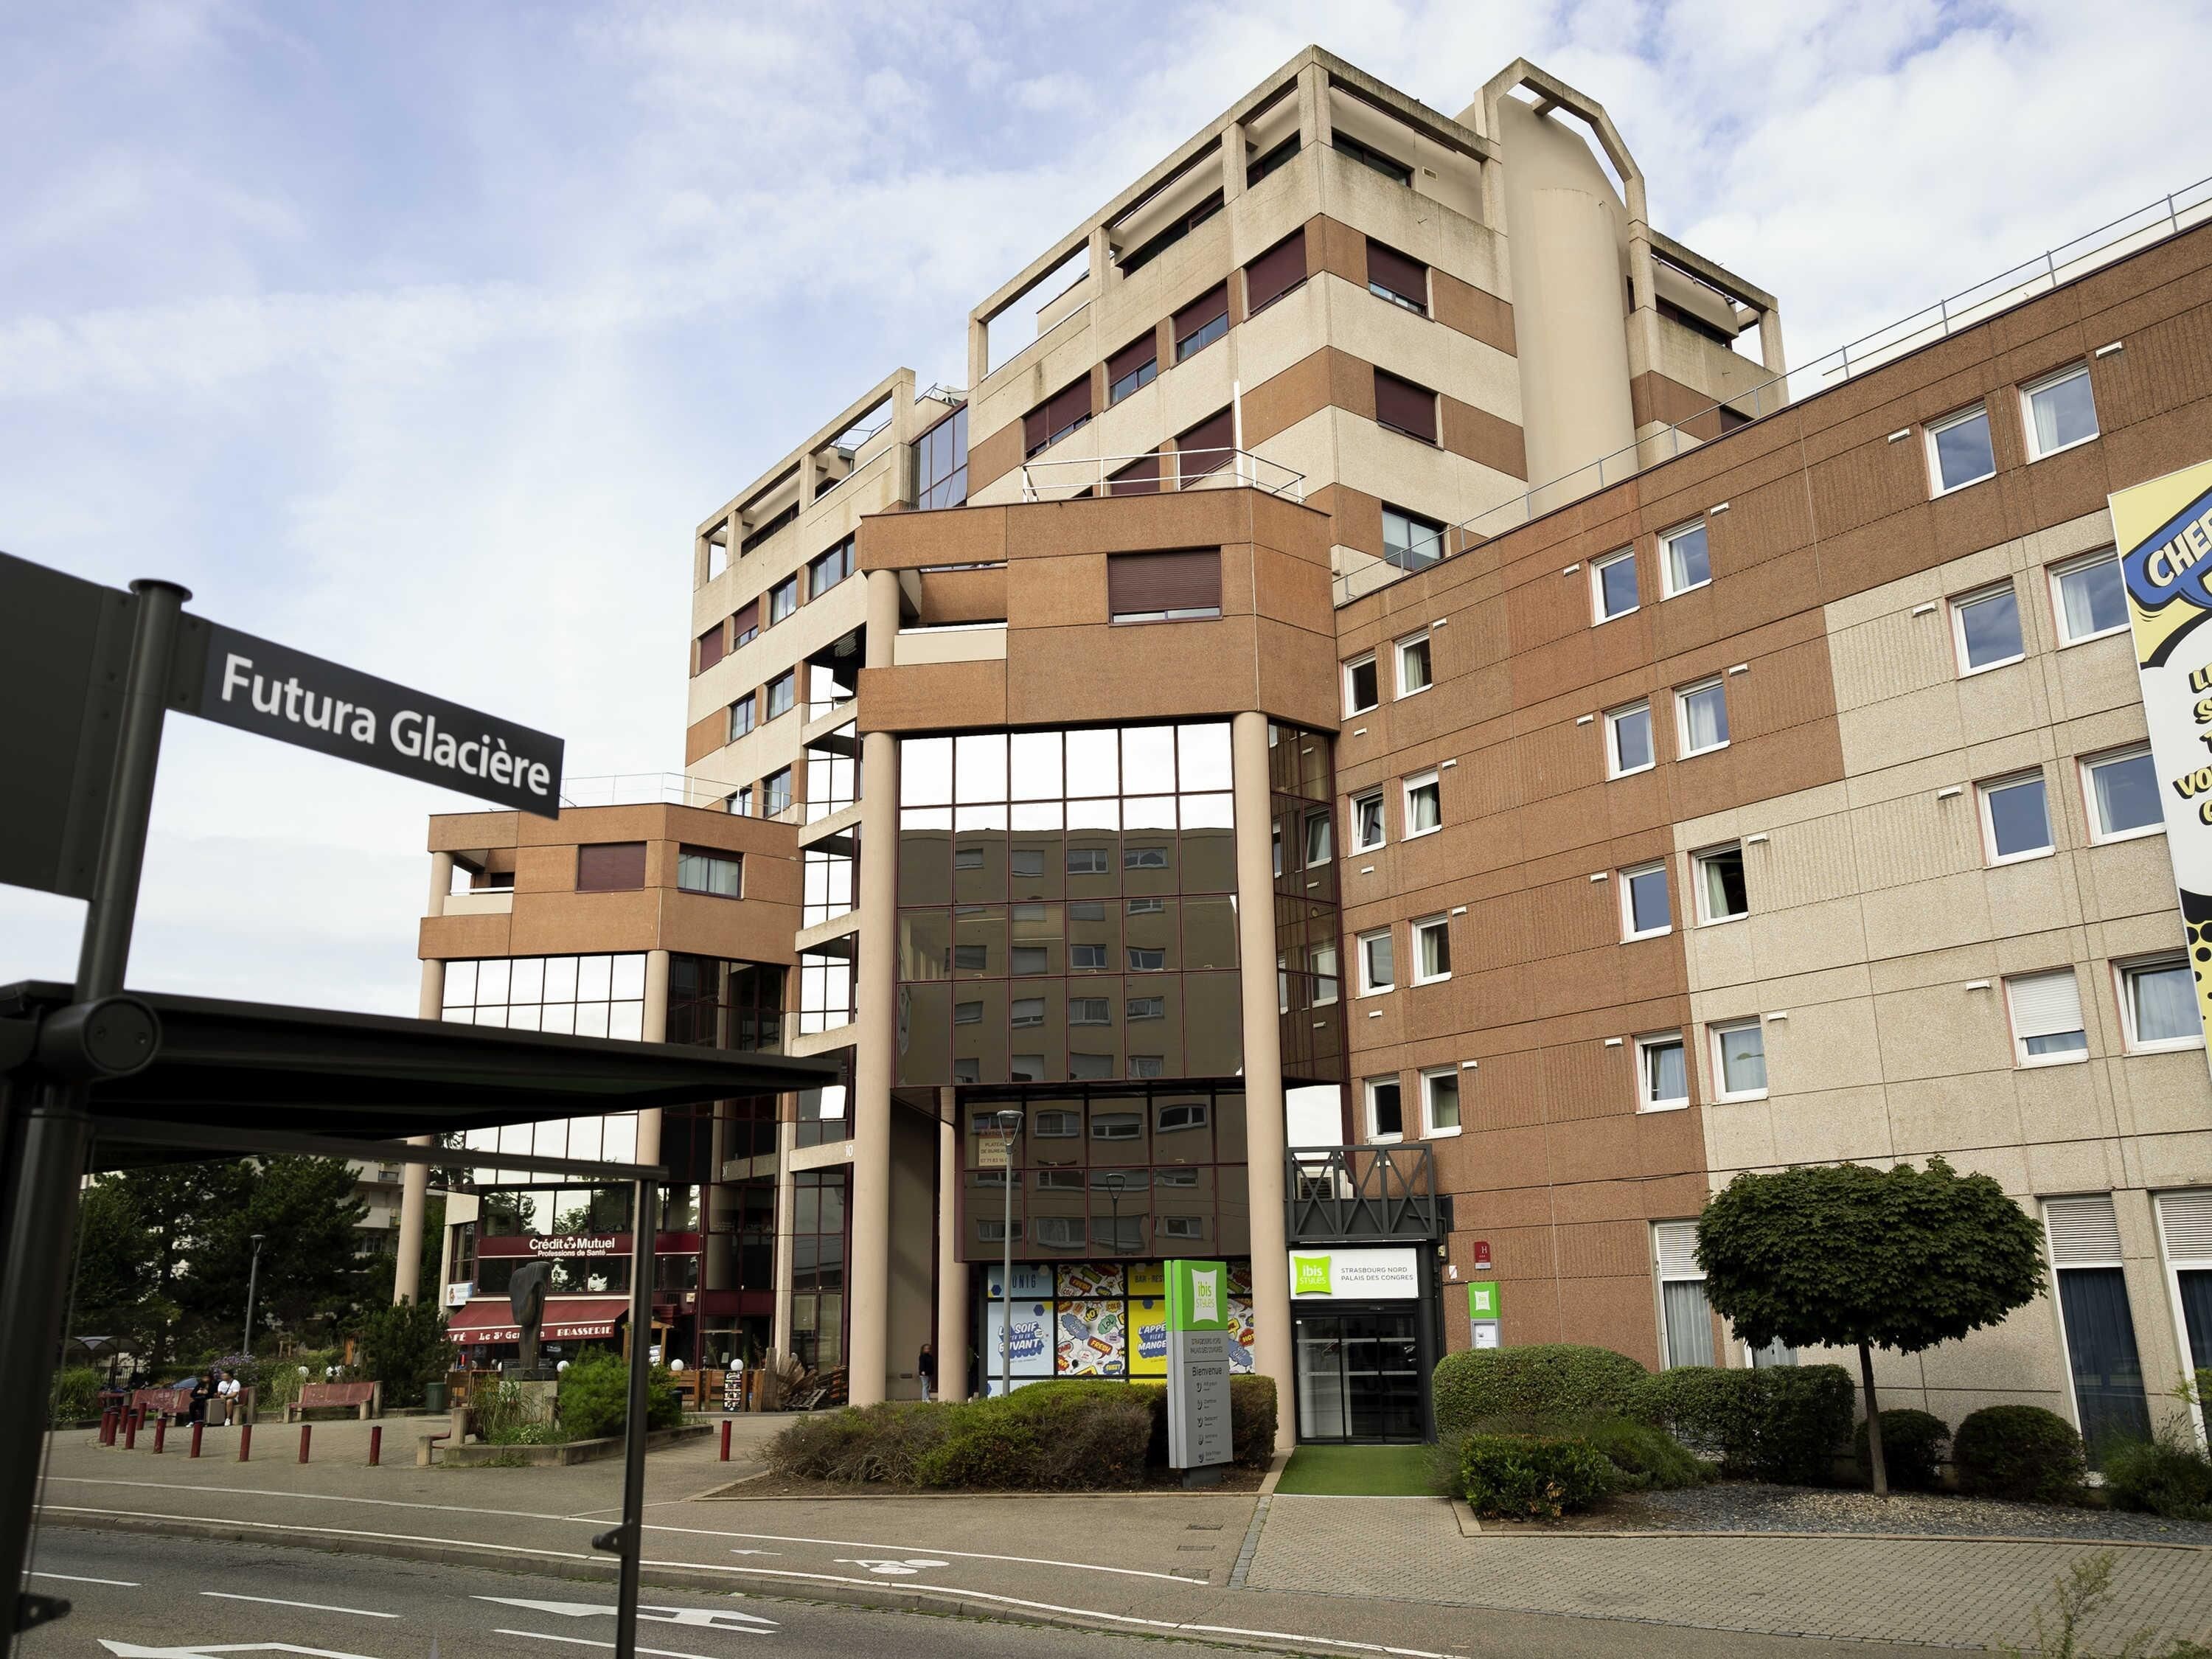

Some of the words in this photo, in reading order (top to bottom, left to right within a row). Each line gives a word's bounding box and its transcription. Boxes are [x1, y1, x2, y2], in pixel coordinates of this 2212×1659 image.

[221, 653, 377, 745] Futura
[389, 710, 552, 796] Glacière
[845, 1144, 853, 1158] 10
[529, 1238, 564, 1250] Crédit
[577, 1237, 615, 1249] Mutuel
[1302, 1264, 1323, 1276] ibis
[1198, 1281, 1211, 1297] ibis
[557, 1326, 611, 1336] BRASSERIE
[1015, 1322, 1037, 1334] SOIF
[1192, 1367, 1222, 1376] Bienvenue
